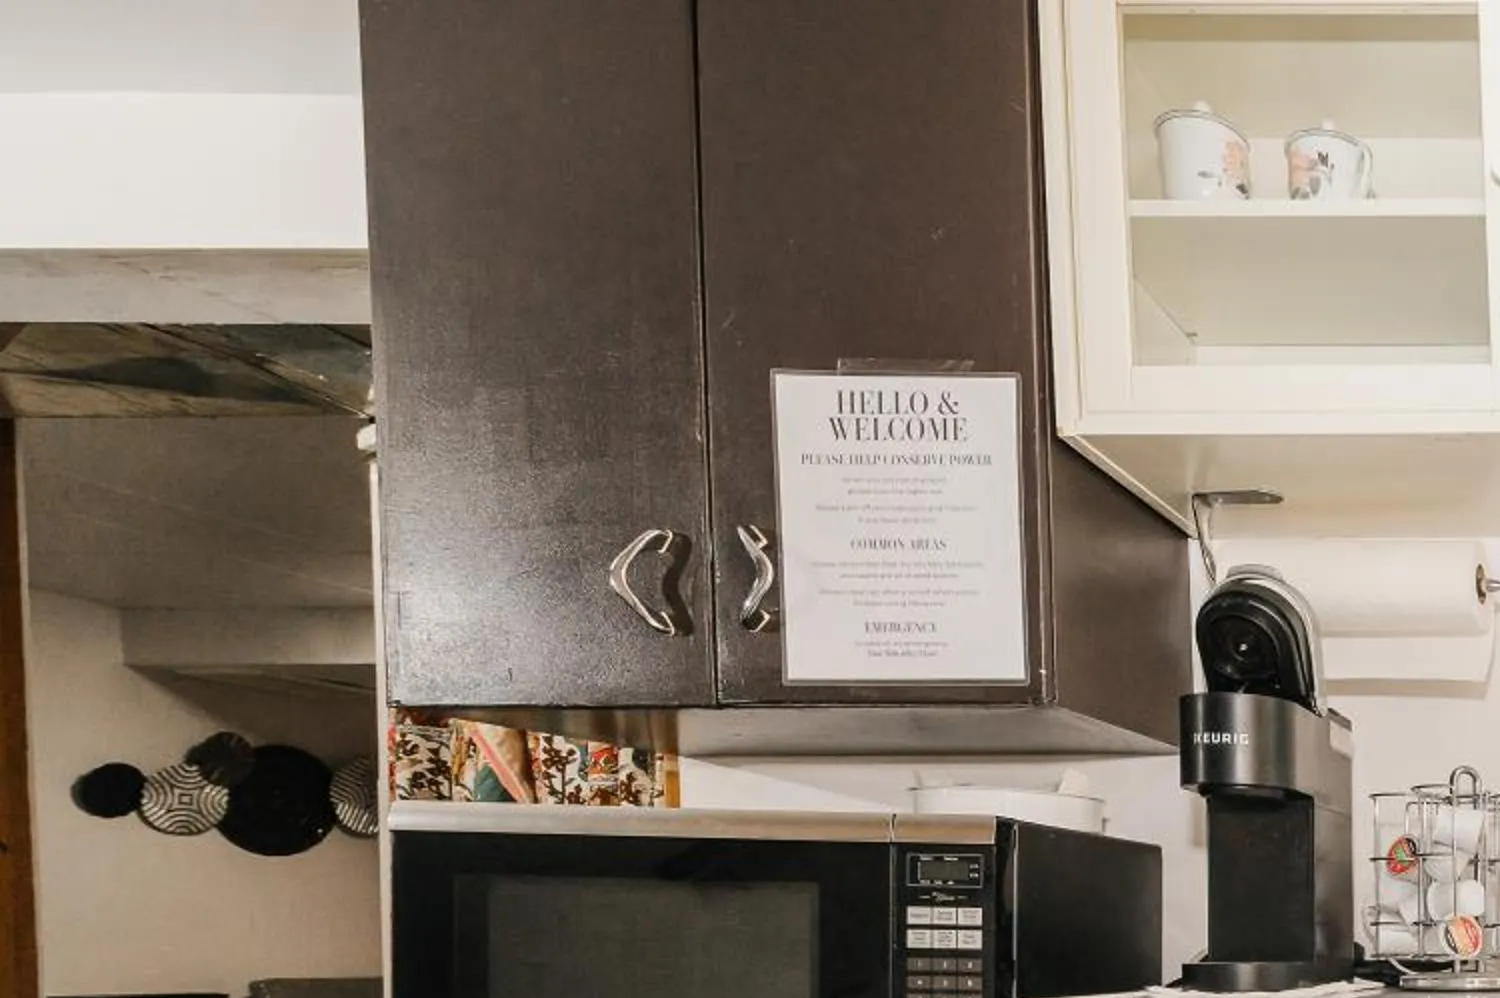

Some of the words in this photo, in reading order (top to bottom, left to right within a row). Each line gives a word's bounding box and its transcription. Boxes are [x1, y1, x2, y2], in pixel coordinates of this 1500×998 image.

[836, 390, 929, 415] HELLO
[937, 391, 960, 415] &
[828, 417, 968, 441] WELCOME
[801, 453, 845, 466] PLEASE
[848, 453, 882, 466] HELP
[883, 453, 945, 466] CONSERVE
[949, 453, 993, 466] POWER
[850, 537, 905, 550] COMMON
[910, 537, 948, 550] AREAS
[864, 621, 938, 633] EMERGENCY
[1193, 732, 1249, 745] KEURIG
